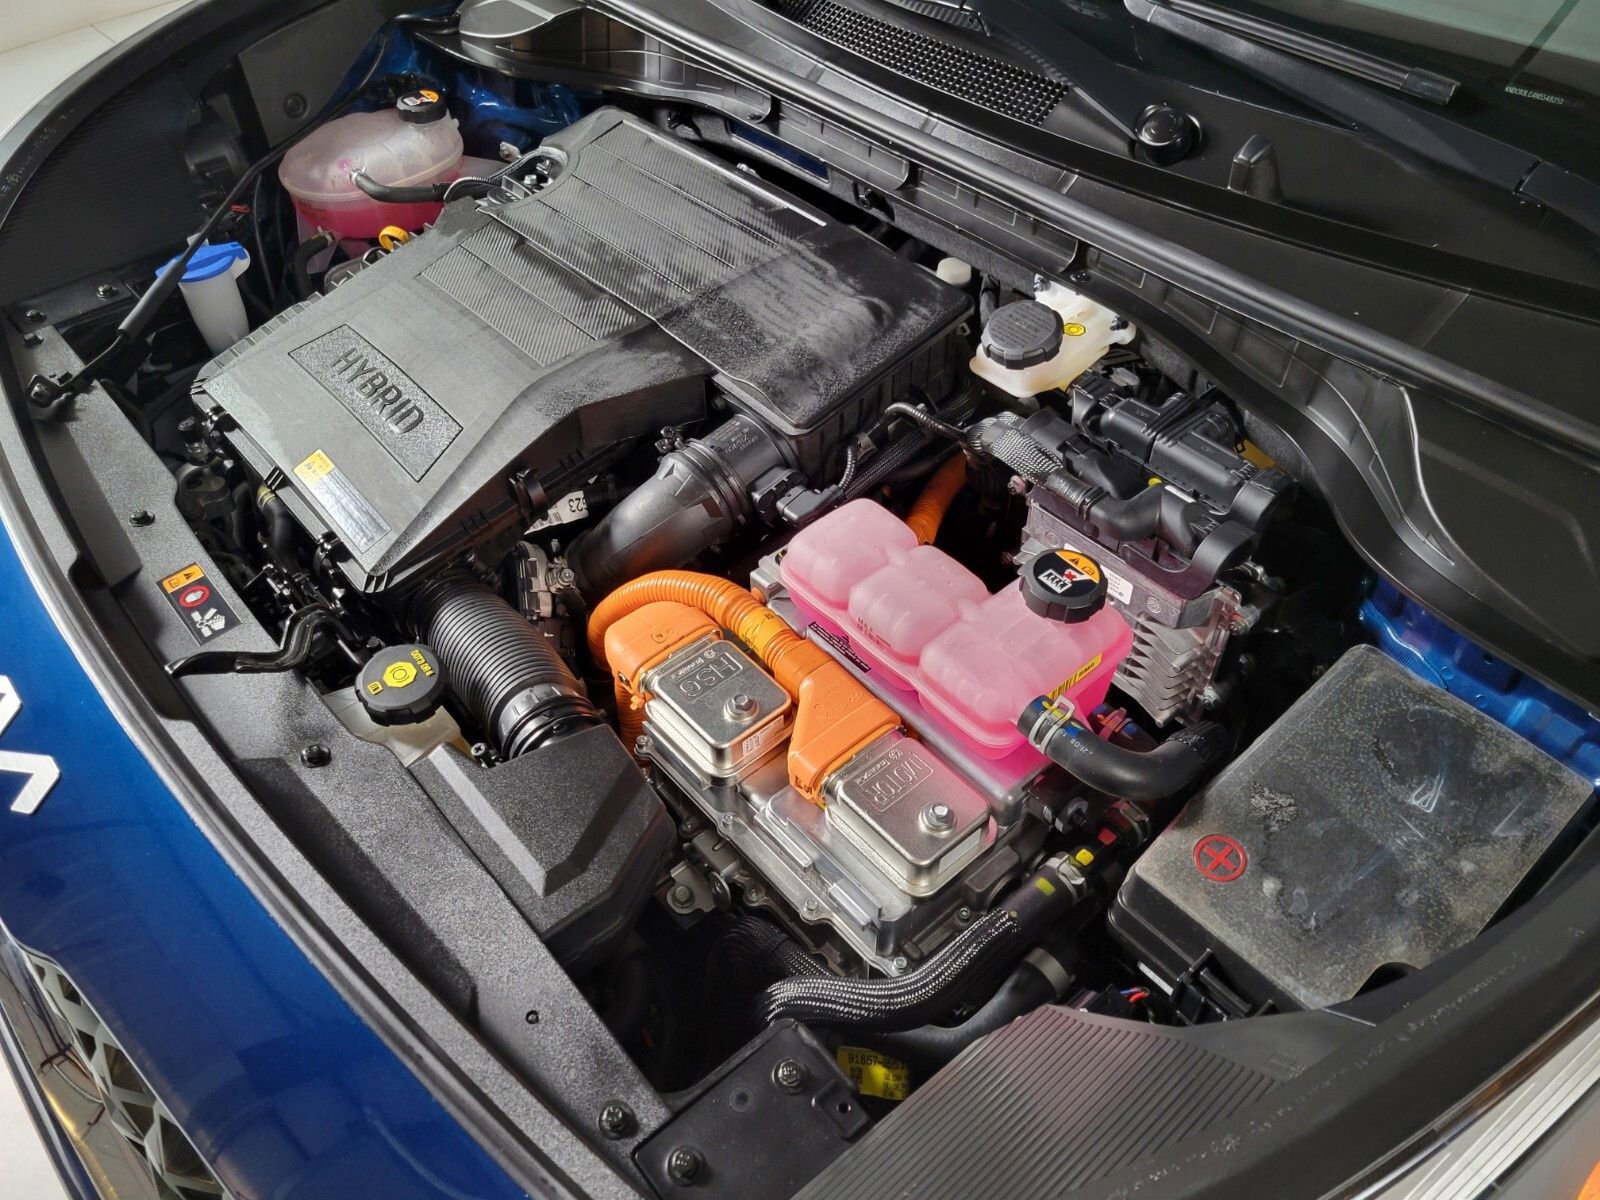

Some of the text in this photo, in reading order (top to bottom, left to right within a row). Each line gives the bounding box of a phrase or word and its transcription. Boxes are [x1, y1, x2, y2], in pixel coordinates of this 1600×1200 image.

[331, 347, 424, 434] HYBRID
[857, 616, 874, 634] MAX
[680, 656, 737, 697] HSG
[865, 756, 922, 805] MOTOR
